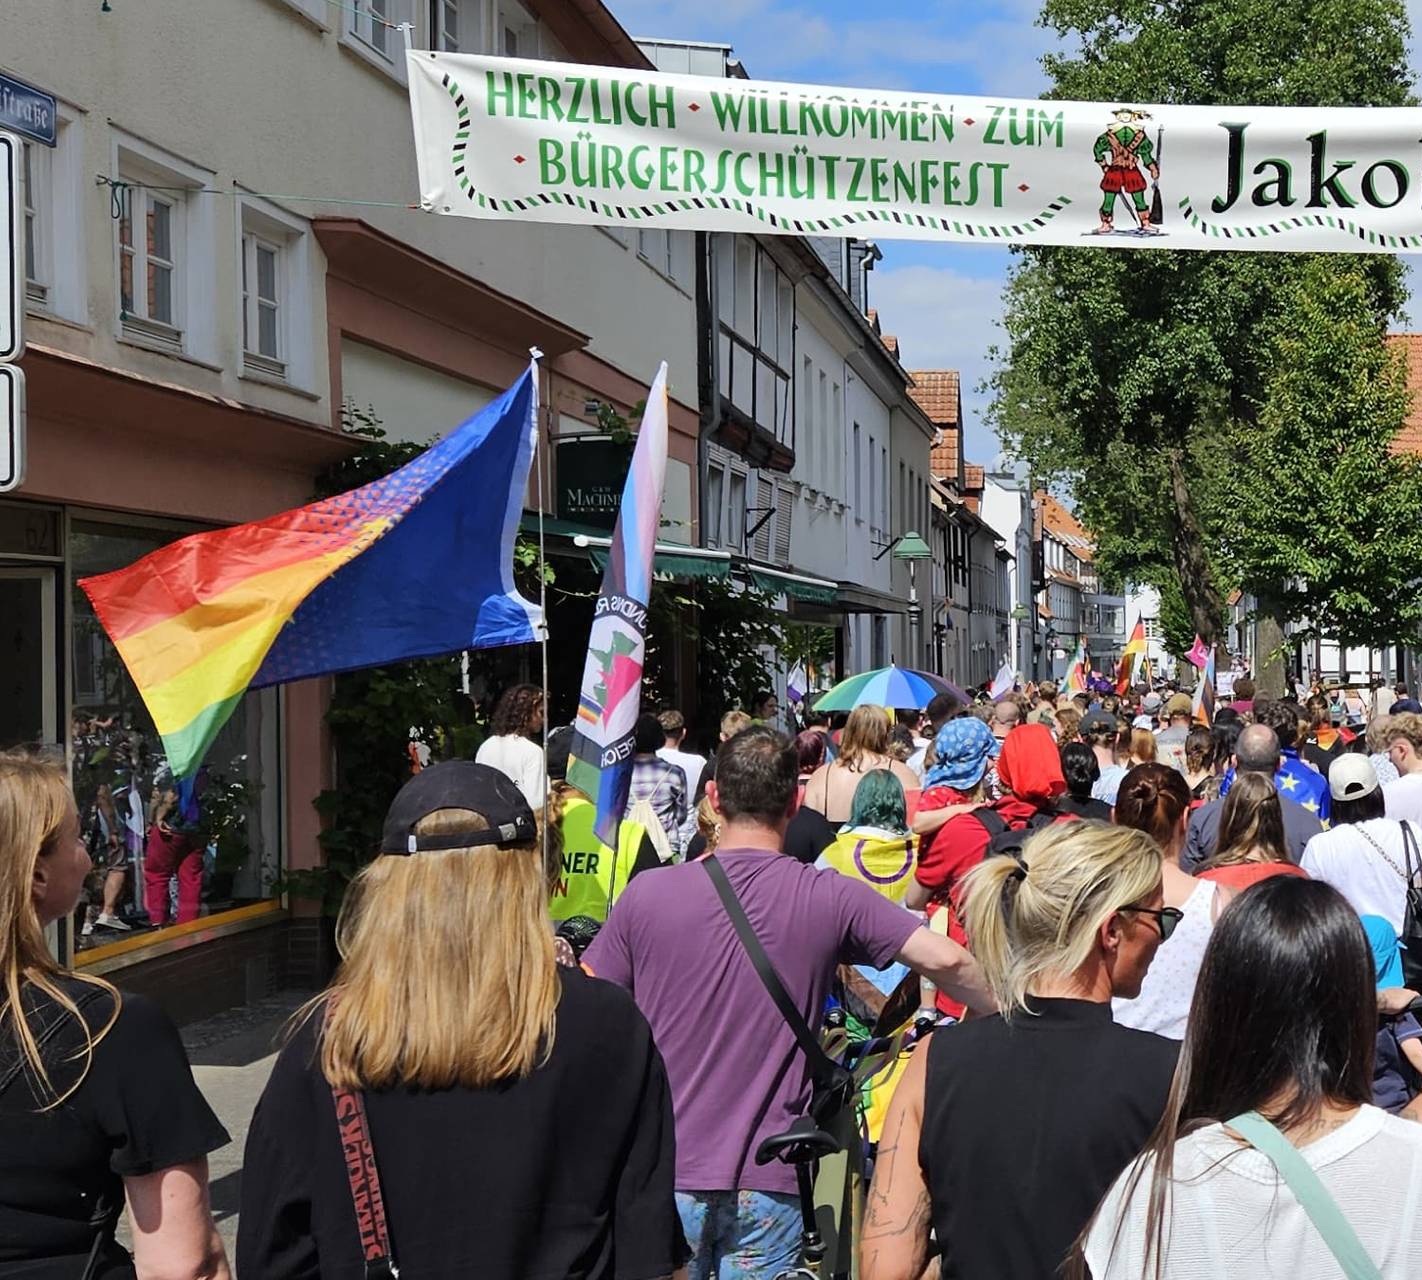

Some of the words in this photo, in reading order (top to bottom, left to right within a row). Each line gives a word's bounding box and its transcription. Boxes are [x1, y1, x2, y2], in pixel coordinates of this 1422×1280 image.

[486, 70, 675, 129] HERZLICH
[710, 85, 955, 143] WILLKOMMEN
[982, 105, 1064, 149] ZUM
[538, 132, 1010, 208] BÜRGERSCHÜTZENFEST
